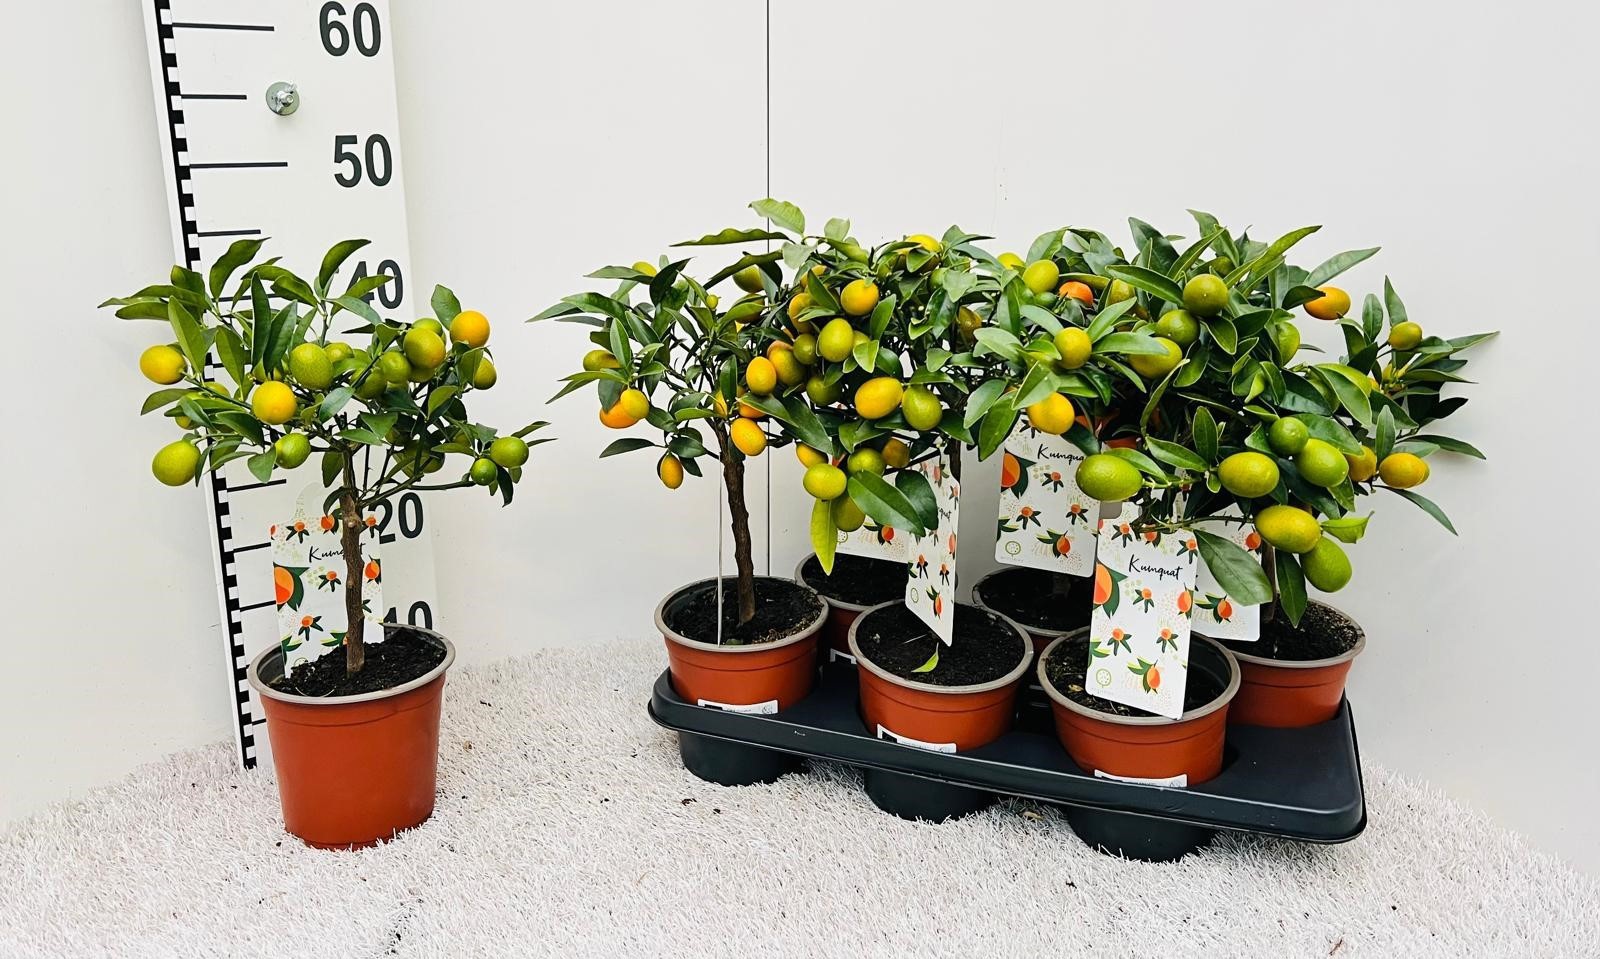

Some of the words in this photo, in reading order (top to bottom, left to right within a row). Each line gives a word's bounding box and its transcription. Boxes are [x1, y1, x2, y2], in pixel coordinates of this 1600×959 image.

[319, 1, 381, 57] 60
[334, 133, 393, 188] 50
[1037, 443, 1085, 466] Kumqua
[367, 492, 423, 544] 20
[309, 542, 366, 563] Kumt
[1128, 554, 1183, 581] Kumquat
